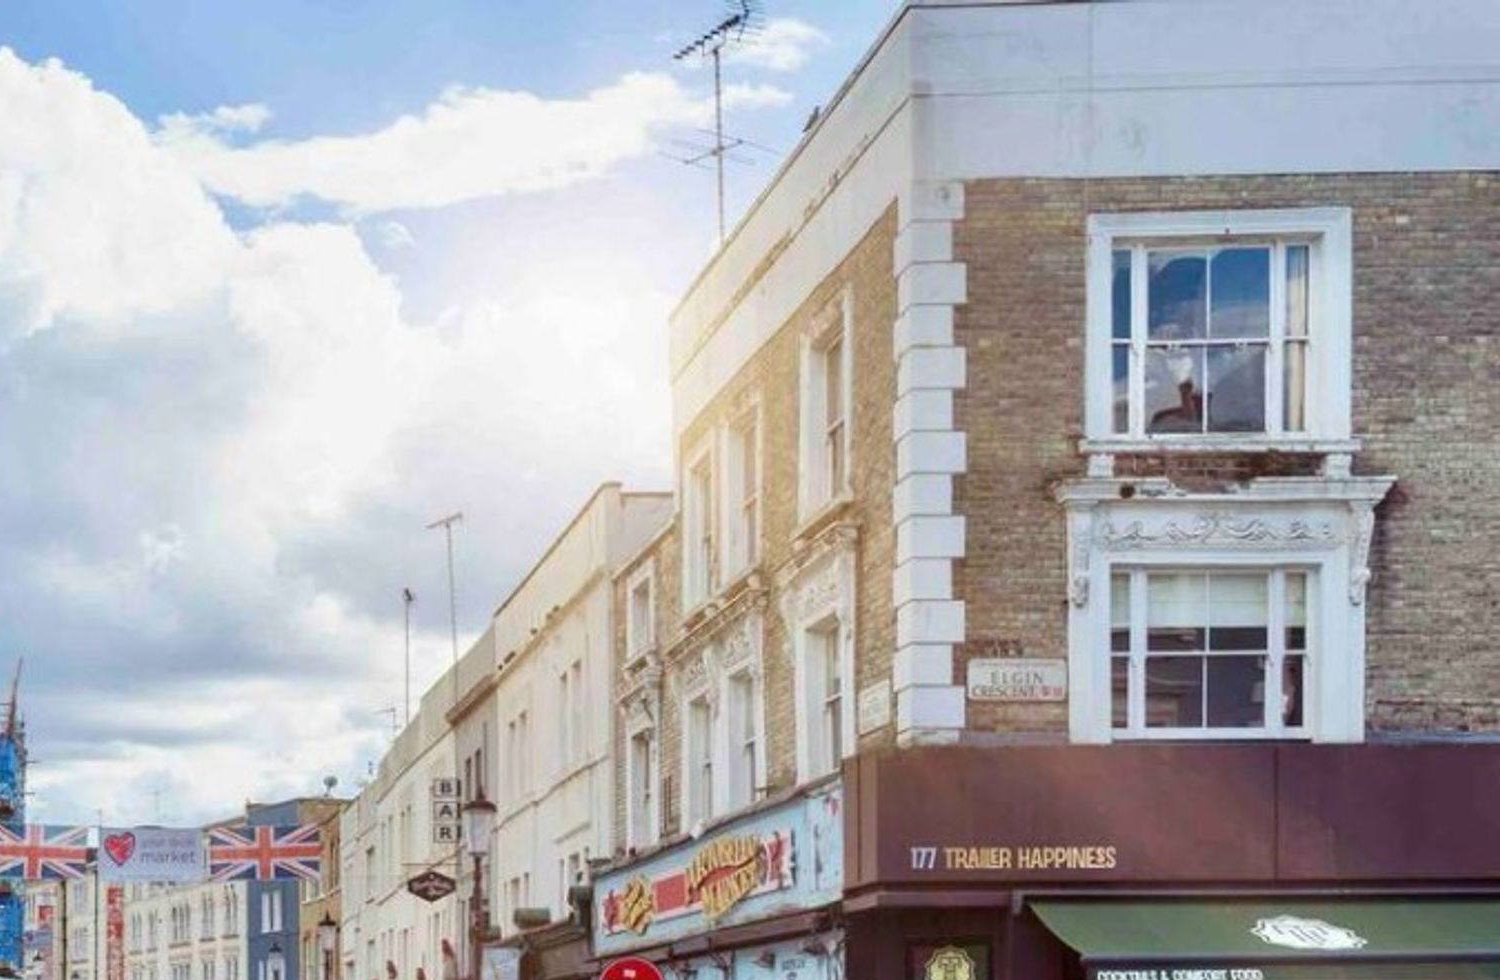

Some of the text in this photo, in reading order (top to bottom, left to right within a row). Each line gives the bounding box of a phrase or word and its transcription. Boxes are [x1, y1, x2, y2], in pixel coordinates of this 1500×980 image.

[990, 671, 1044, 685] ELGIN
[439, 781, 454, 839] BAR
[140, 852, 197, 864] market
[910, 845, 1117, 870] 177 TRAILER HAPPINESS
